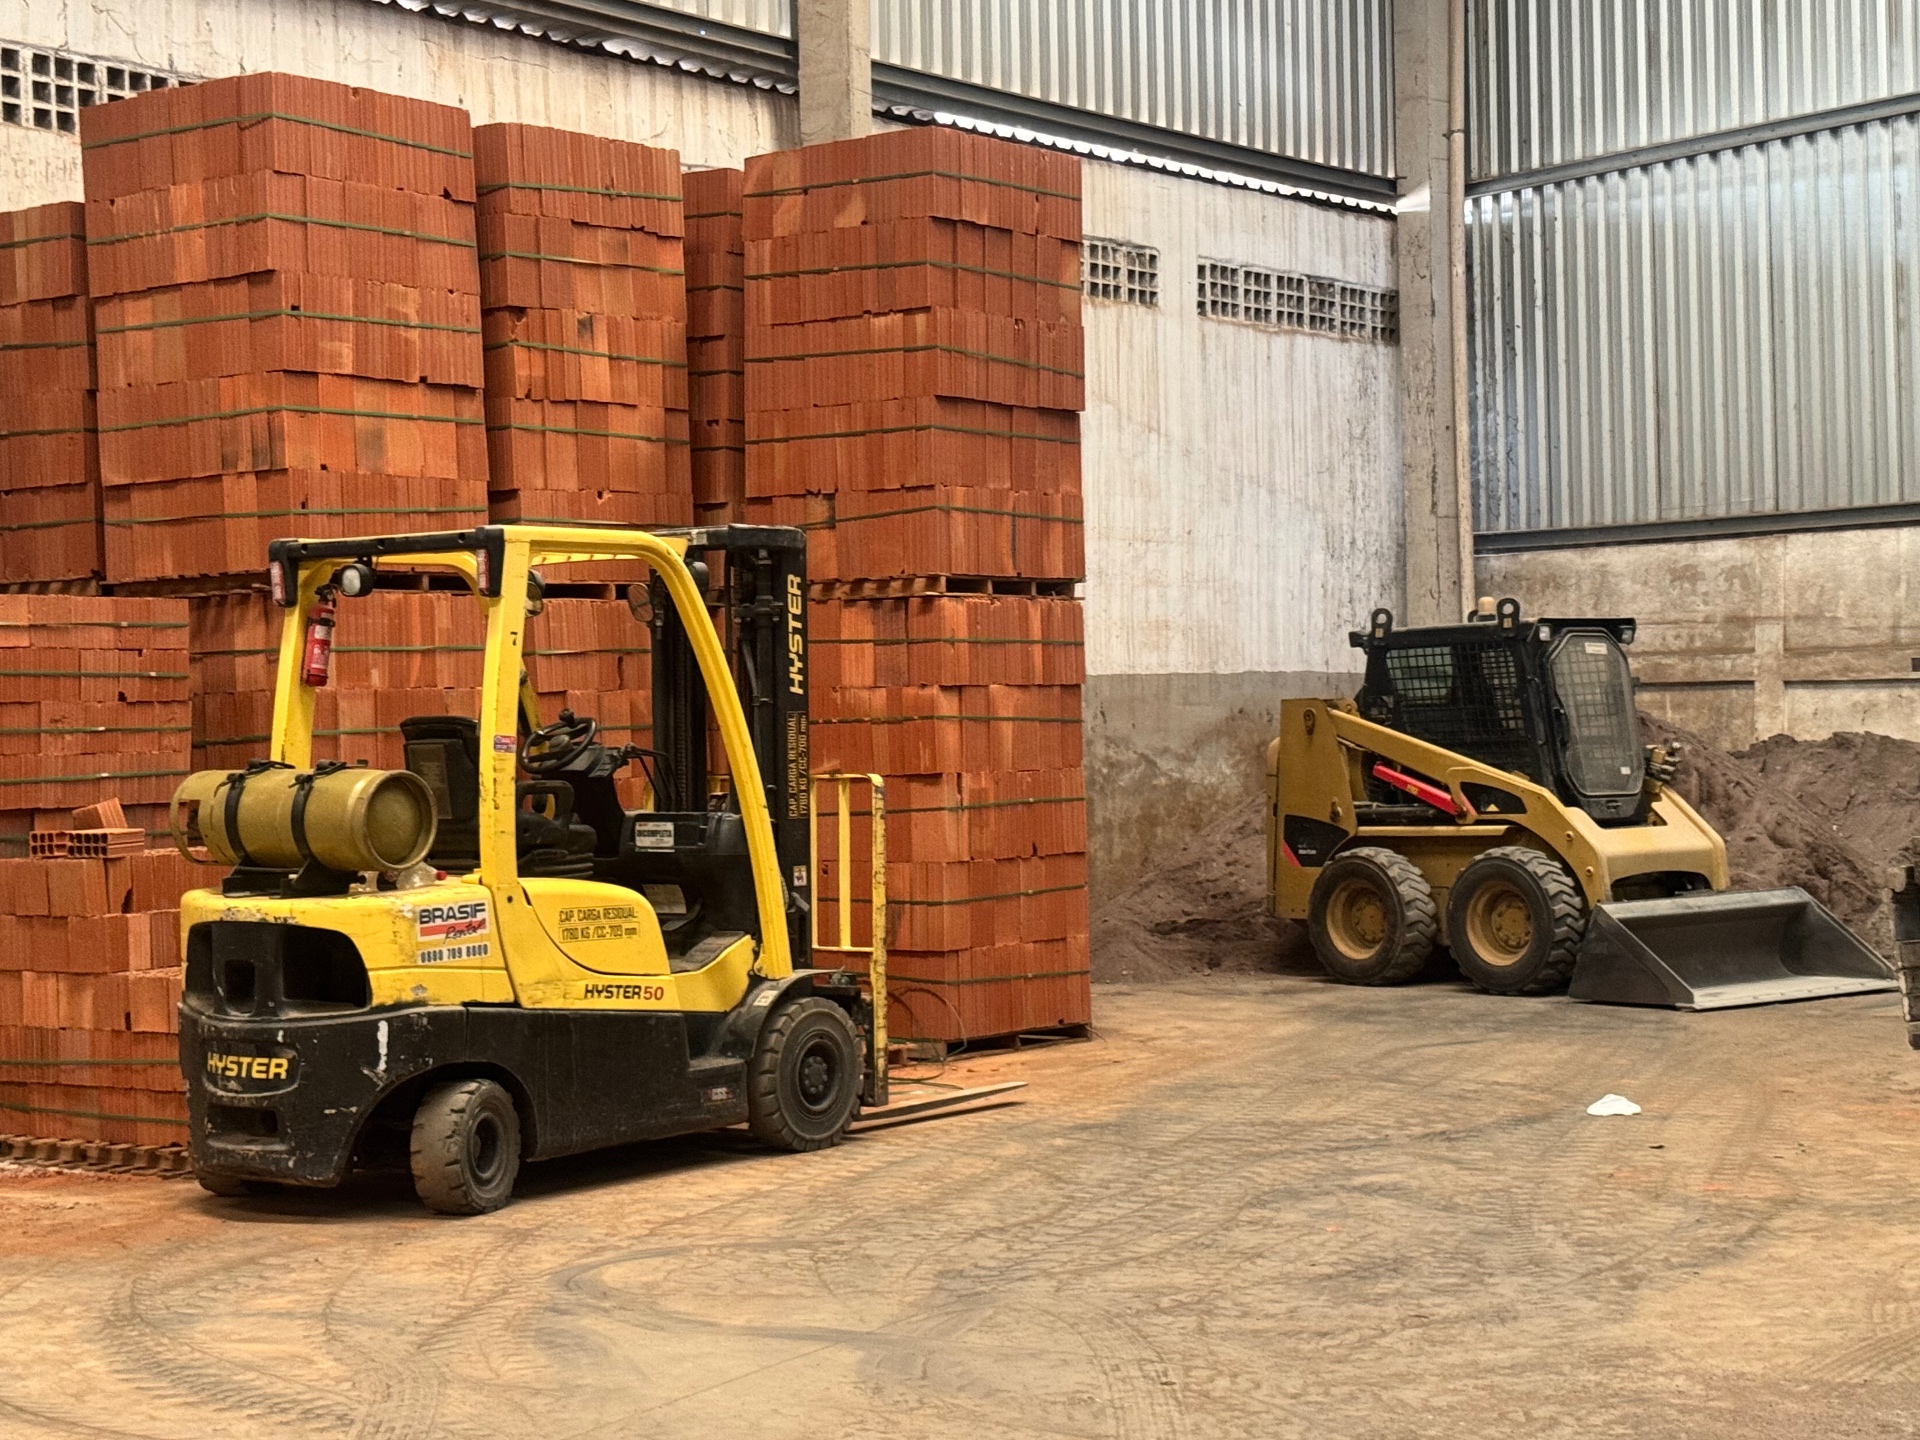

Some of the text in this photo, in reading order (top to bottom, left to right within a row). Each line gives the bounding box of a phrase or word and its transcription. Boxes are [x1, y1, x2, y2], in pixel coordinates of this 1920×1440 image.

[787, 574, 804, 695] HYSTER
[787, 717, 797, 760] RESIDUAL
[787, 762, 798, 793] CARGA
[798, 777, 808, 790] KG
[419, 902, 486, 925] BRASIF
[603, 906, 638, 920] RESIDUAL
[584, 984, 664, 1001] HYSTER 50
[206, 1051, 289, 1079] HYSTER
